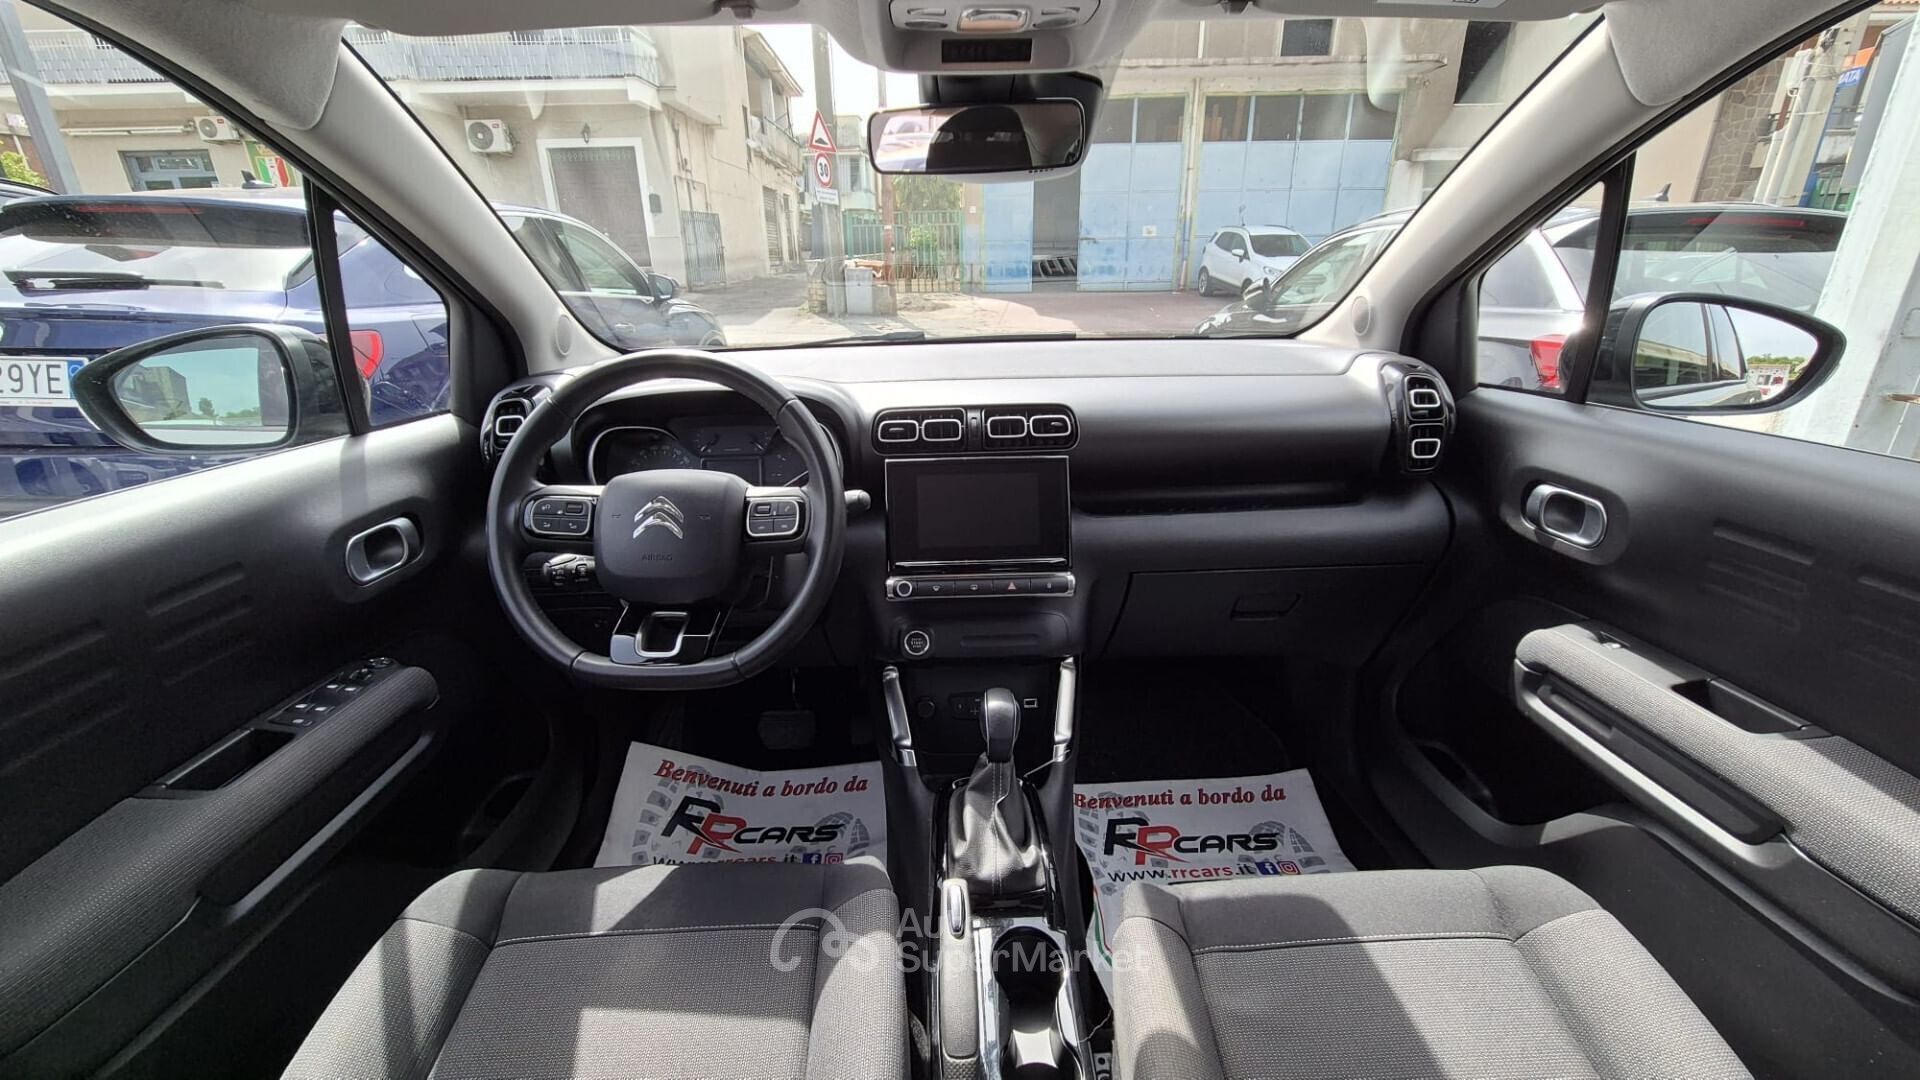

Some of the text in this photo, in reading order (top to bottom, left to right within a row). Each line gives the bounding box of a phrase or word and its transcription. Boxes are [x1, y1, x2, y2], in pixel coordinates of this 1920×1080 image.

[819, 162, 828, 177] 30
[0, 363, 63, 394] 9YE
[653, 760, 869, 796] Benvenuti a bordo da
[1073, 784, 1287, 809] Benvenuti a bordo da
[1108, 862, 1255, 883] www.rrcars.it
